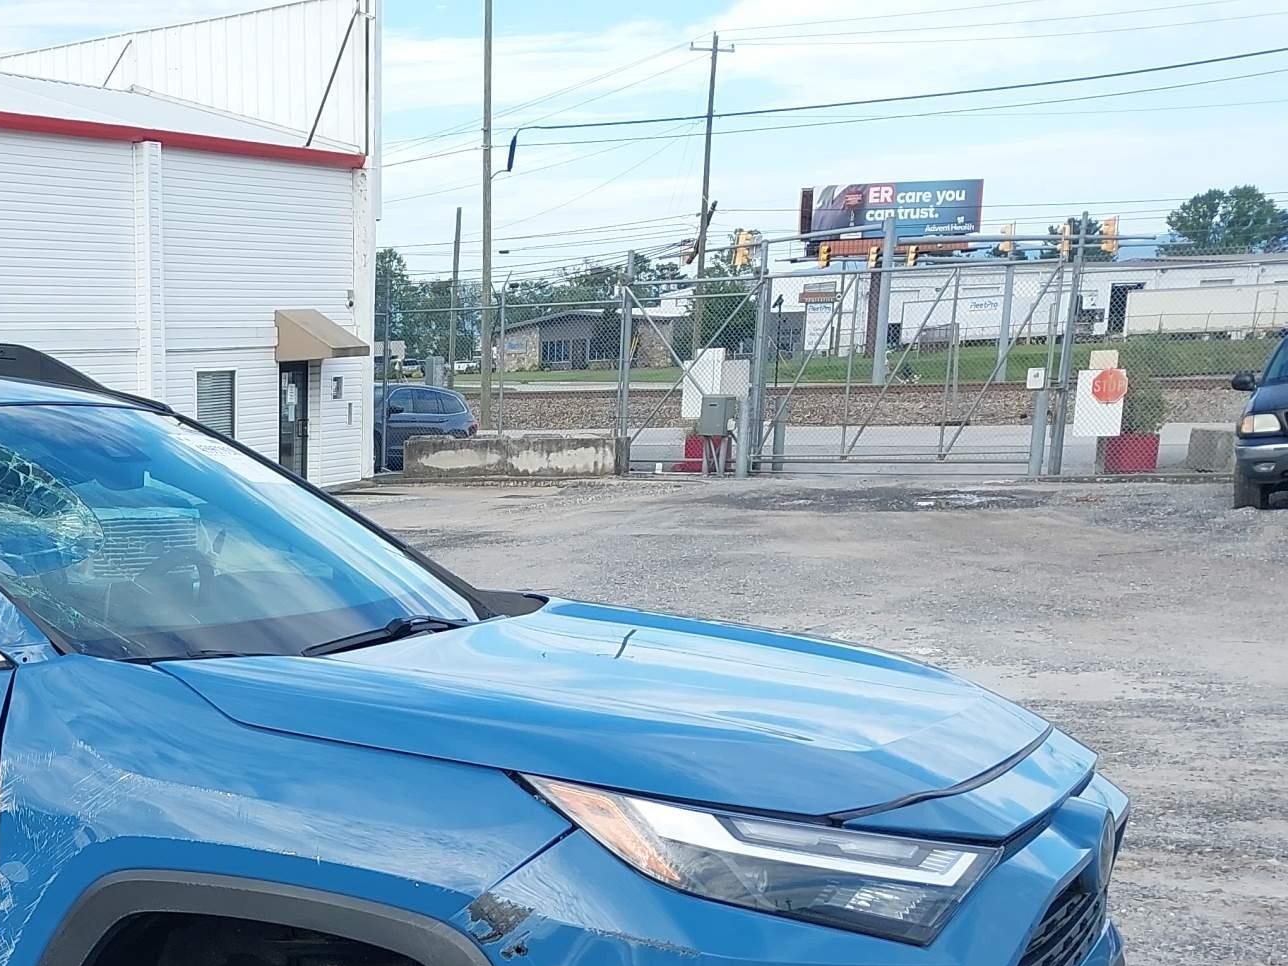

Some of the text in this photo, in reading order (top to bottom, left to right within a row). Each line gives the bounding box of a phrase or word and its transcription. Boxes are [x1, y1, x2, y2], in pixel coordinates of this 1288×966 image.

[869, 186, 966, 205] ER care you
[865, 205, 940, 221] can trust.
[1094, 380, 1125, 393] STOP
